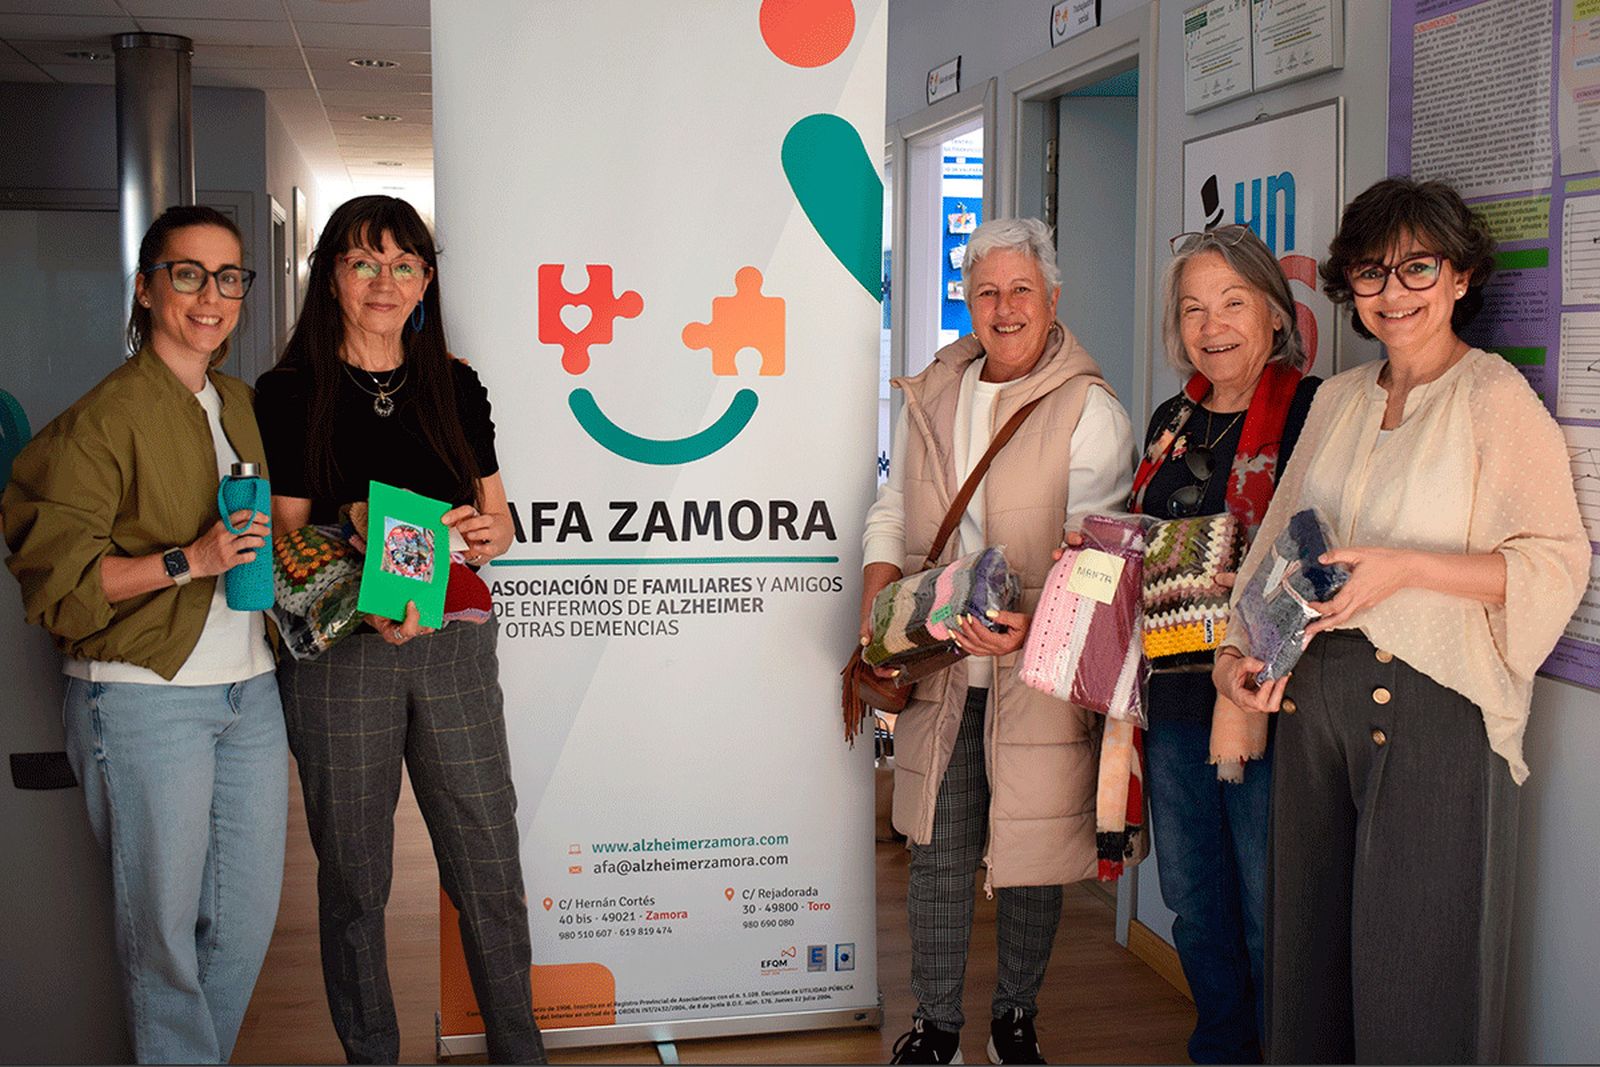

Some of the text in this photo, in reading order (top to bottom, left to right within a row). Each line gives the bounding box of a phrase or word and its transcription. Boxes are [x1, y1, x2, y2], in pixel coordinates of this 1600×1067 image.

[609, 500, 837, 542] ZAMORA
[491, 574, 843, 596] ASOCIACIÓN DE FAMILIARES Y AMIGOS
[521, 600, 623, 617] ENFERMOS
[628, 600, 651, 615] DE
[657, 597, 764, 615] ALZHEIMER
[506, 620, 565, 638] OTRAS
[571, 619, 680, 637] DEMENCIAS
[592, 834, 789, 853] www.alzheimerzamora.com
[593, 854, 789, 876] afa@alzheimerzamora.com
[742, 886, 819, 900] C/ Rejadorada
[559, 895, 655, 911] C/ Hernán Cortés
[742, 901, 831, 915] 30 49800 Toro
[559, 910, 688, 925] 40 bis 49021 Zamora
[742, 918, 795, 929] 980 690 080
[559, 926, 673, 940] 980 510 607 619 819 474
[761, 959, 788, 968] EFQM
[800, 986, 827, 994] UTILIDAD
[828, 984, 854, 992] PÚBLICA
